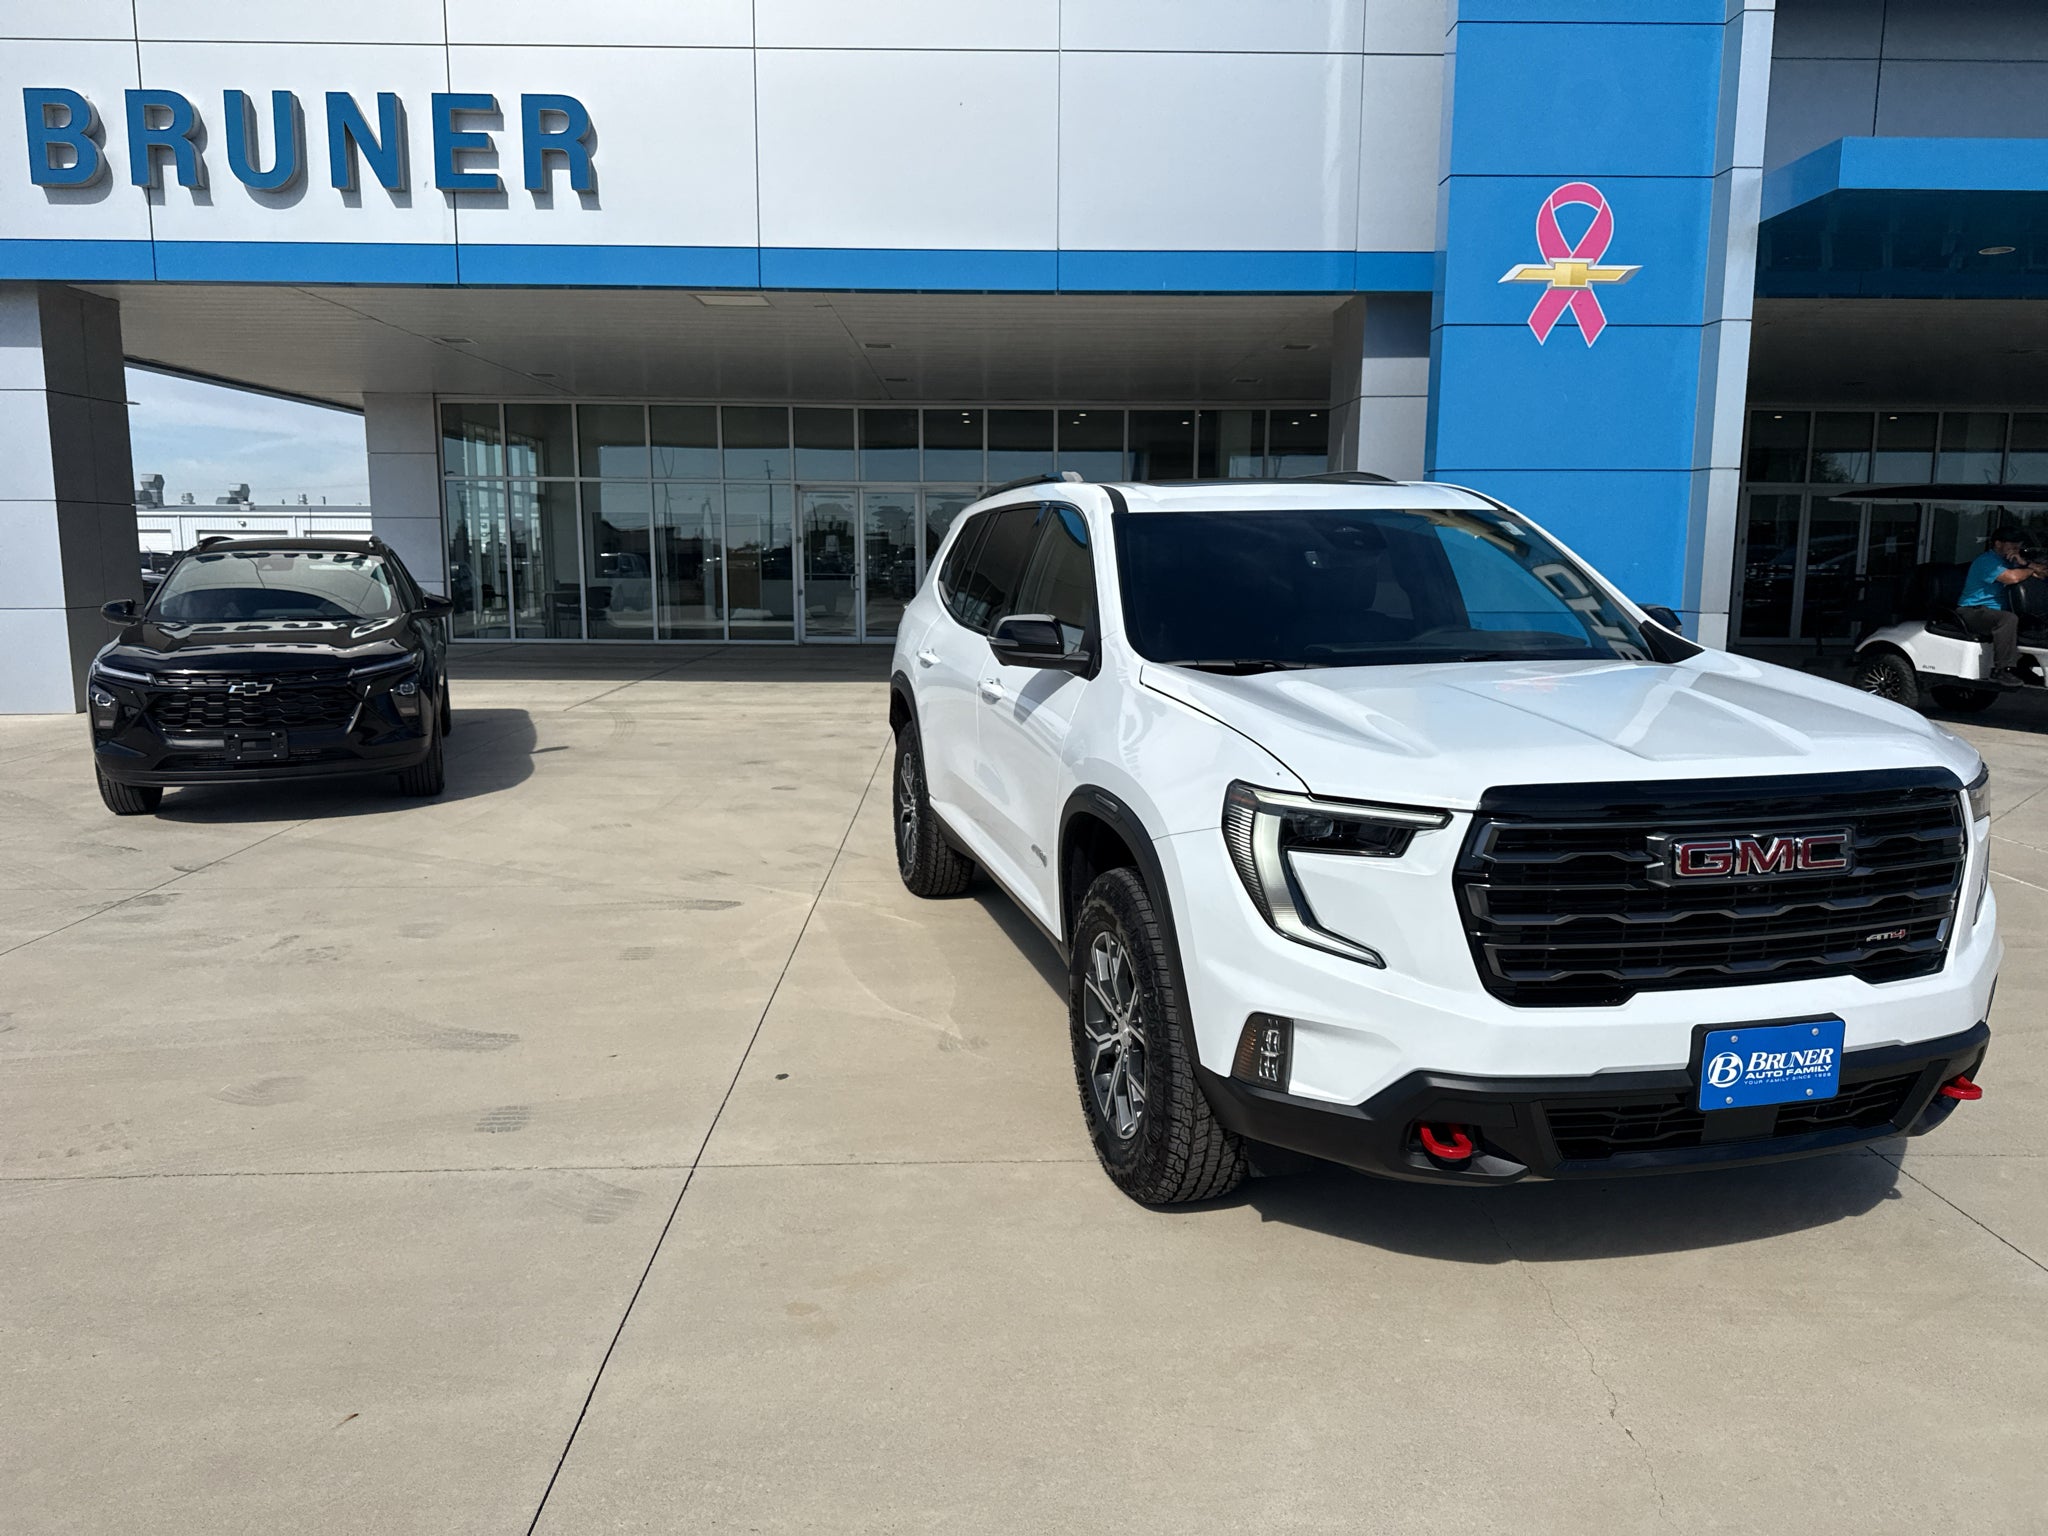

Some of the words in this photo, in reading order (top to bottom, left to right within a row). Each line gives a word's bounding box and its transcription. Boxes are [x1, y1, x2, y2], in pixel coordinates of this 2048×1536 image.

[23, 87, 598, 195] BRUNER
[1674, 833, 1847, 877] GMC
[1745, 1070, 1783, 1080] AUTO
[1786, 1064, 1833, 1076] FAMILY
[1746, 1047, 1835, 1072] BRUNER
